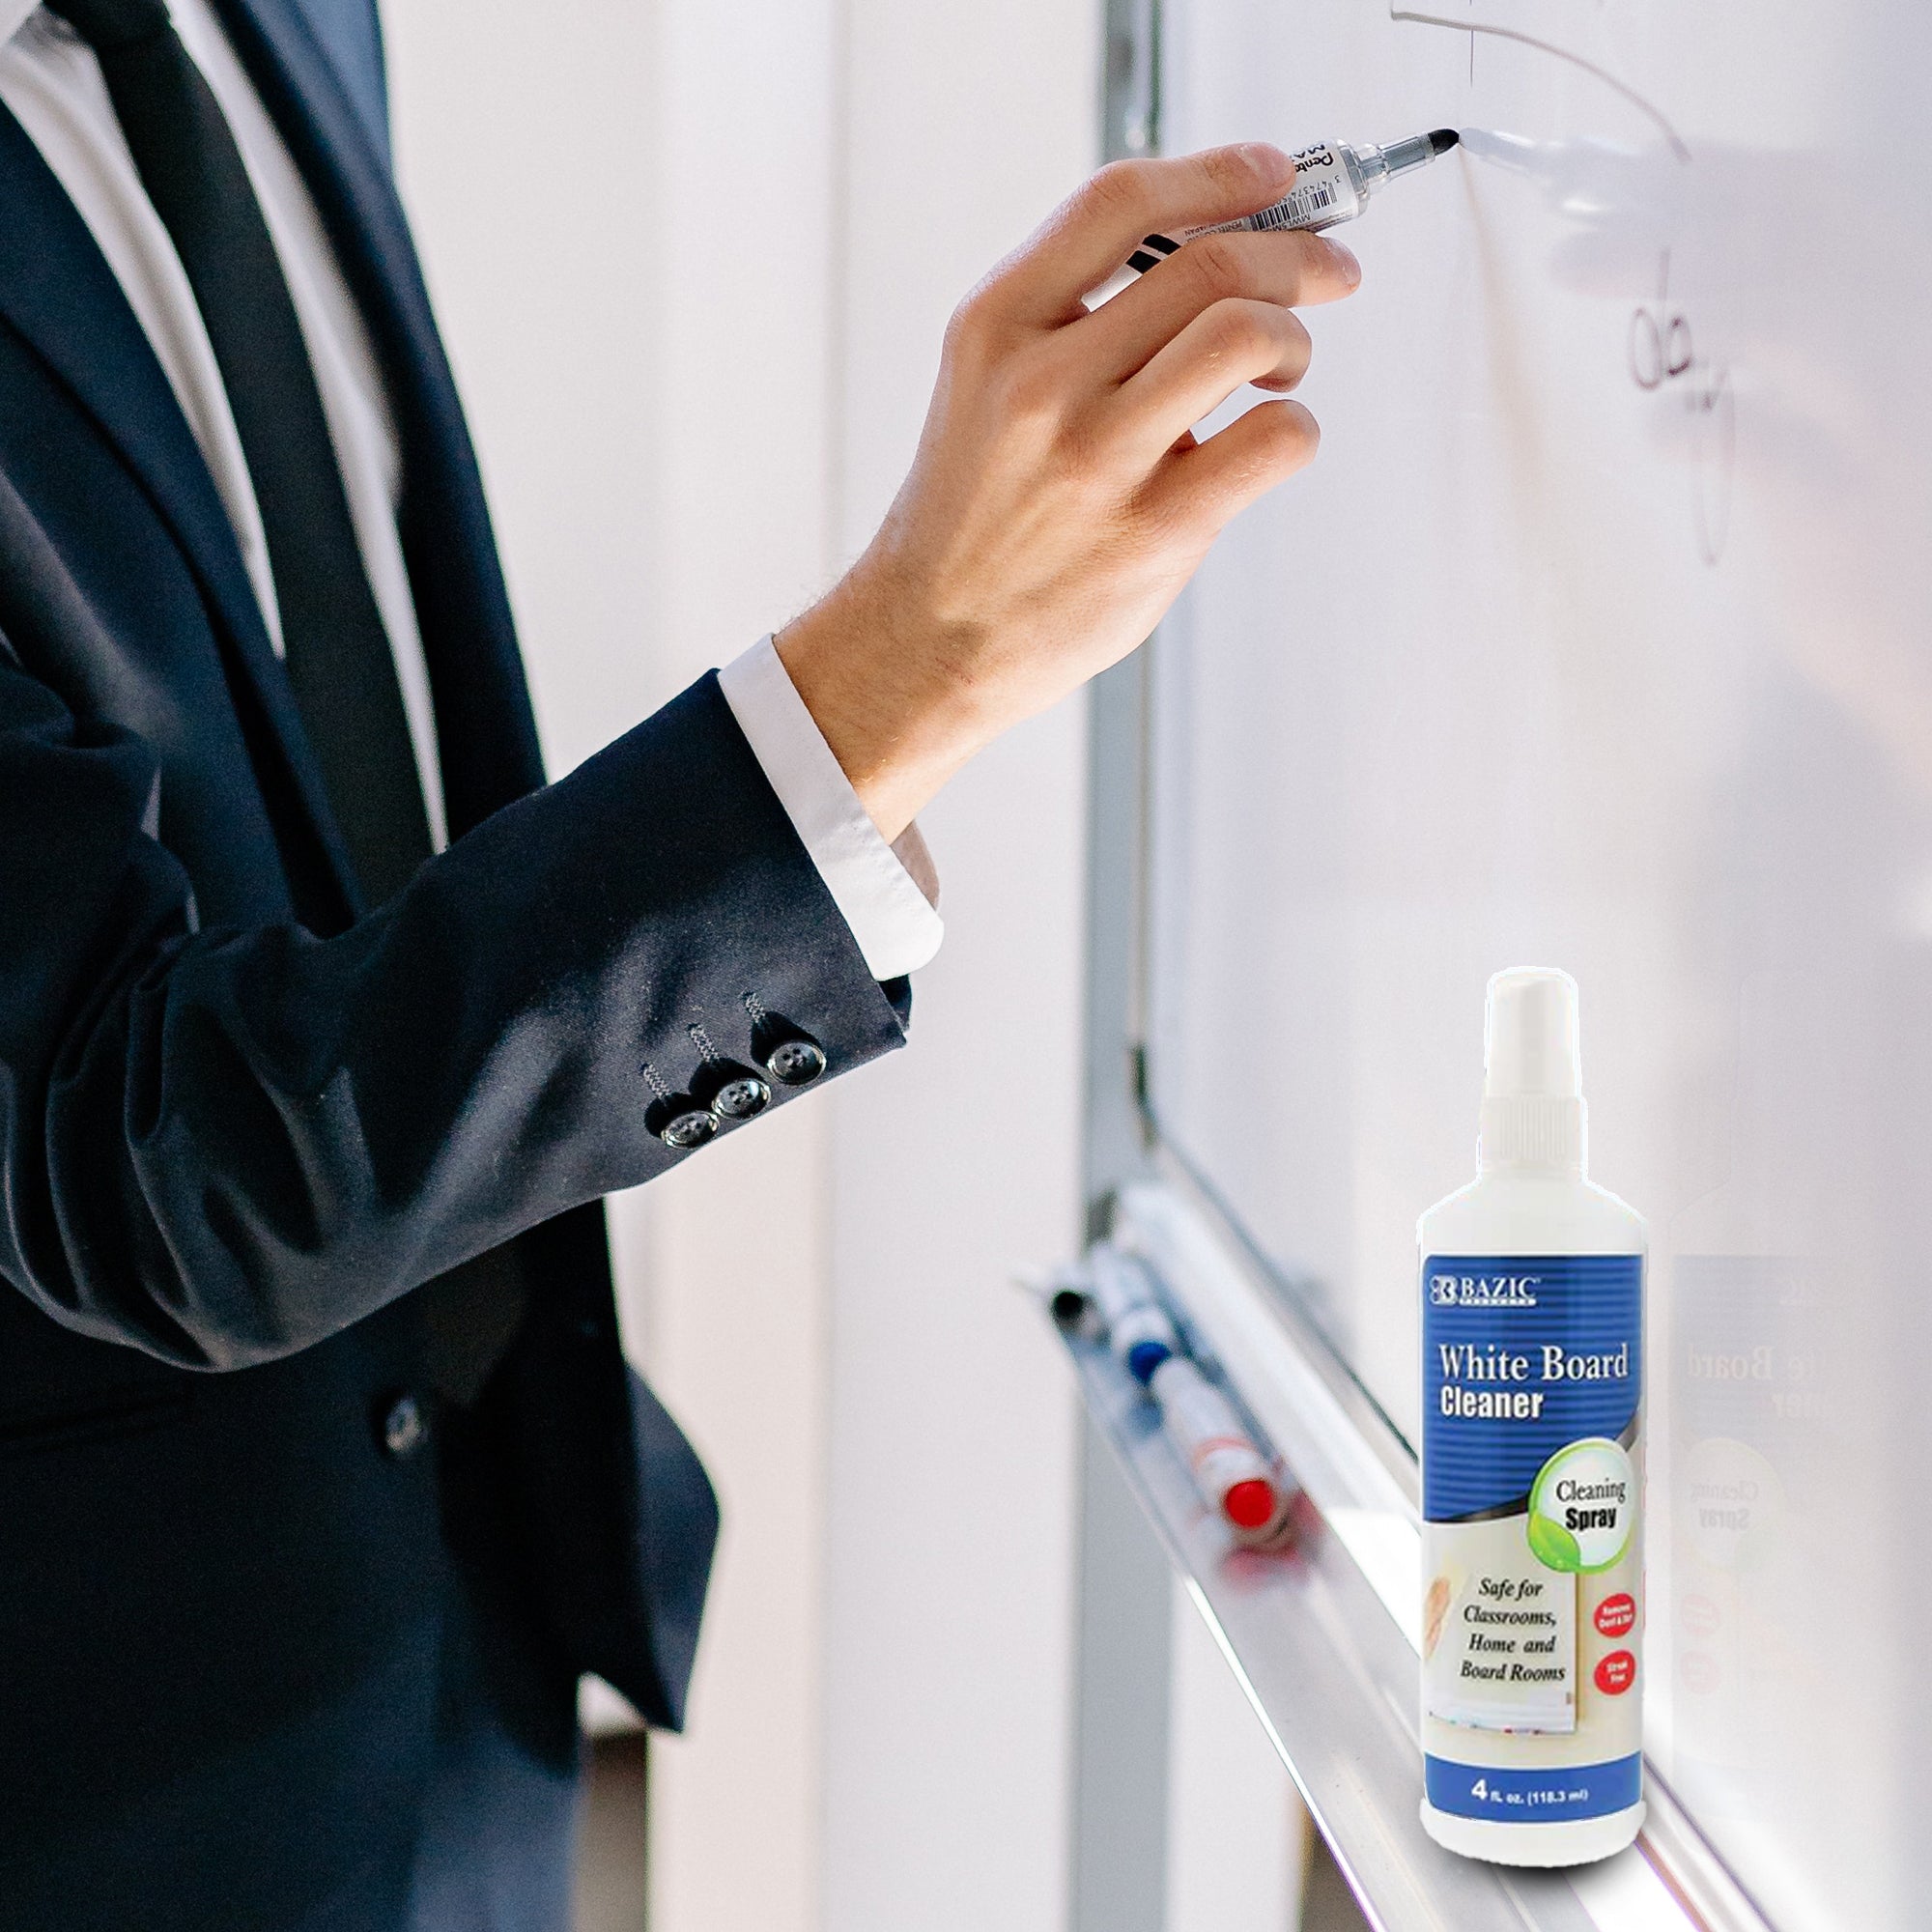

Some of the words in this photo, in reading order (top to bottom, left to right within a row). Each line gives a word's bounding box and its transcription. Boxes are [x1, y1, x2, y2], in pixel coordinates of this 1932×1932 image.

[1290, 144, 1325, 161] MA
[1334, 175, 1342, 184] 3
[1461, 1276, 1537, 1298] BAZIC
[1438, 1344, 1529, 1380] White
[1541, 1342, 1629, 1380] Board
[1440, 1385, 1544, 1418] Cleaner
[1555, 1477, 1626, 1503] Cleaning
[1565, 1507, 1617, 1532] Spray
[1478, 1577, 1515, 1601] Safe
[1515, 1578, 1545, 1602] for
[1463, 1605, 1558, 1627] Classrooms,
[1468, 1633, 1517, 1654] Home
[1522, 1635, 1557, 1654] and
[1460, 1660, 1508, 1681] Board
[1509, 1663, 1567, 1682] Rooms
[1470, 1778, 1489, 1801] 4
